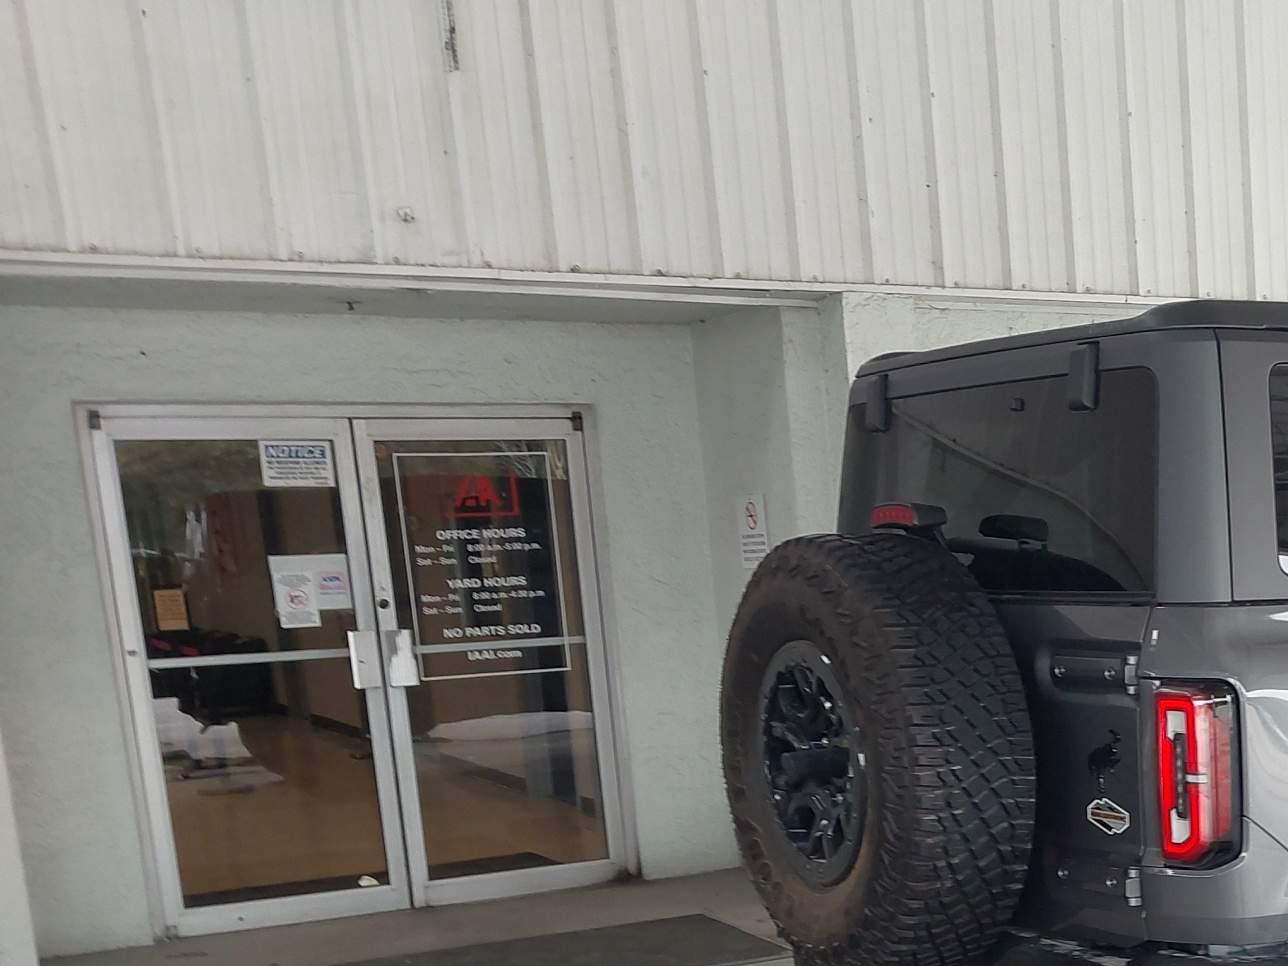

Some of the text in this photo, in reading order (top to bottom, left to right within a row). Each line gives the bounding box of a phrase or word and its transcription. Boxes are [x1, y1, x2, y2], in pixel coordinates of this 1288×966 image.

[265, 446, 325, 458] NOTICE
[436, 527, 526, 540] OFFICE HOURS
[467, 556, 496, 564] Closed
[446, 575, 527, 589] YARD HOURS
[473, 603, 502, 612] Closed
[443, 622, 541, 638] NO PARTS SOLD
[467, 649, 523, 661] IAAI.com
